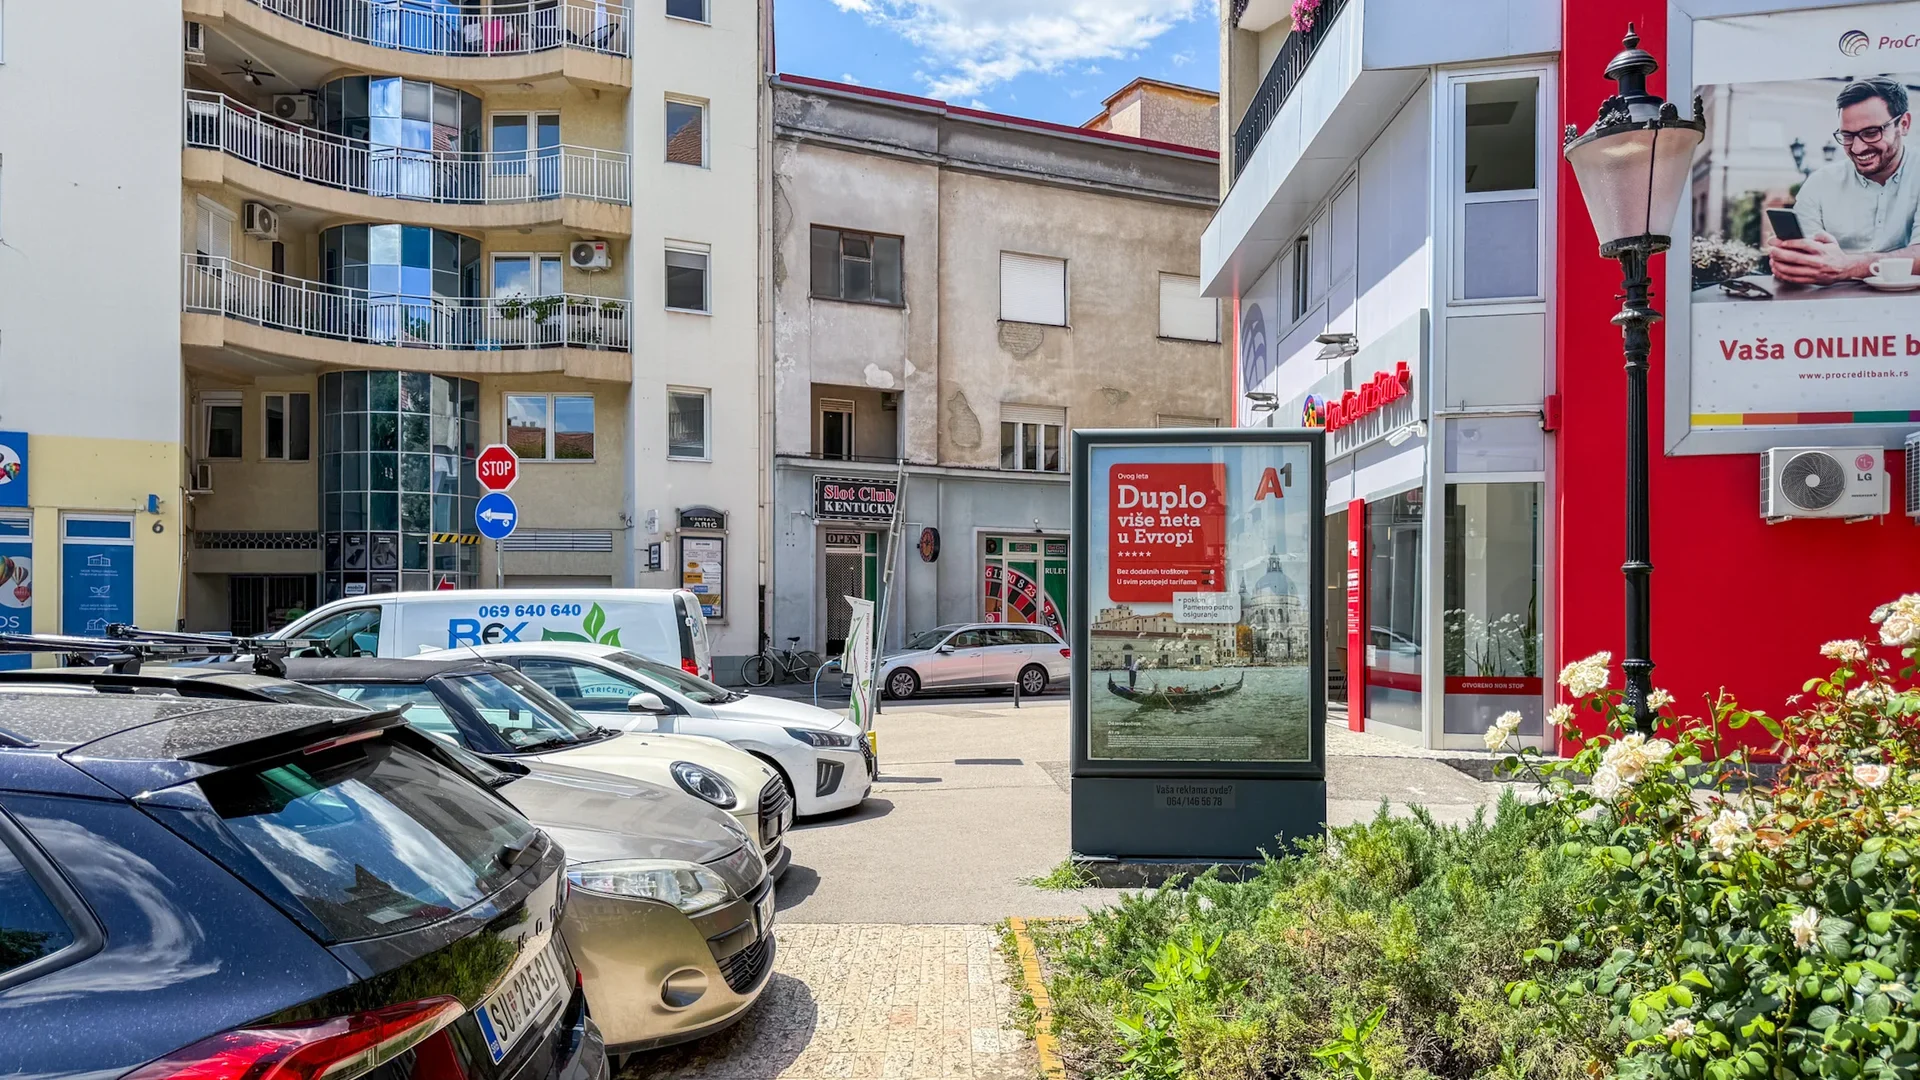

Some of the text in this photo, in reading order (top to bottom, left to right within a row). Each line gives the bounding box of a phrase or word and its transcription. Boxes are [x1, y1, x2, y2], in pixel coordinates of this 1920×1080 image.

[1719, 337, 1785, 361] Vaša
[1794, 336, 1897, 359] ONLINE
[1799, 369, 1909, 381] www.procreditbank.rs
[482, 461, 512, 476] STOP
[1255, 463, 1292, 500] A1
[1857, 473, 1872, 481] LG
[824, 485, 896, 502] Slot Club
[1117, 484, 1207, 514] Duplo
[824, 500, 895, 514] KENTUCKY
[152, 519, 164, 534] 6
[1117, 512, 1201, 527] više neta
[827, 534, 860, 544] OPEN
[1117, 529, 1194, 547] u Evropi
[1017, 579, 1025, 588] 8
[1024, 584, 1036, 597] 23
[479, 604, 582, 618] 069 640 640
[1156, 785, 1233, 795] Vaša reklama ovde?
[1166, 797, 1223, 807] 064/146 56 78
[489, 994, 517, 1043] SU
